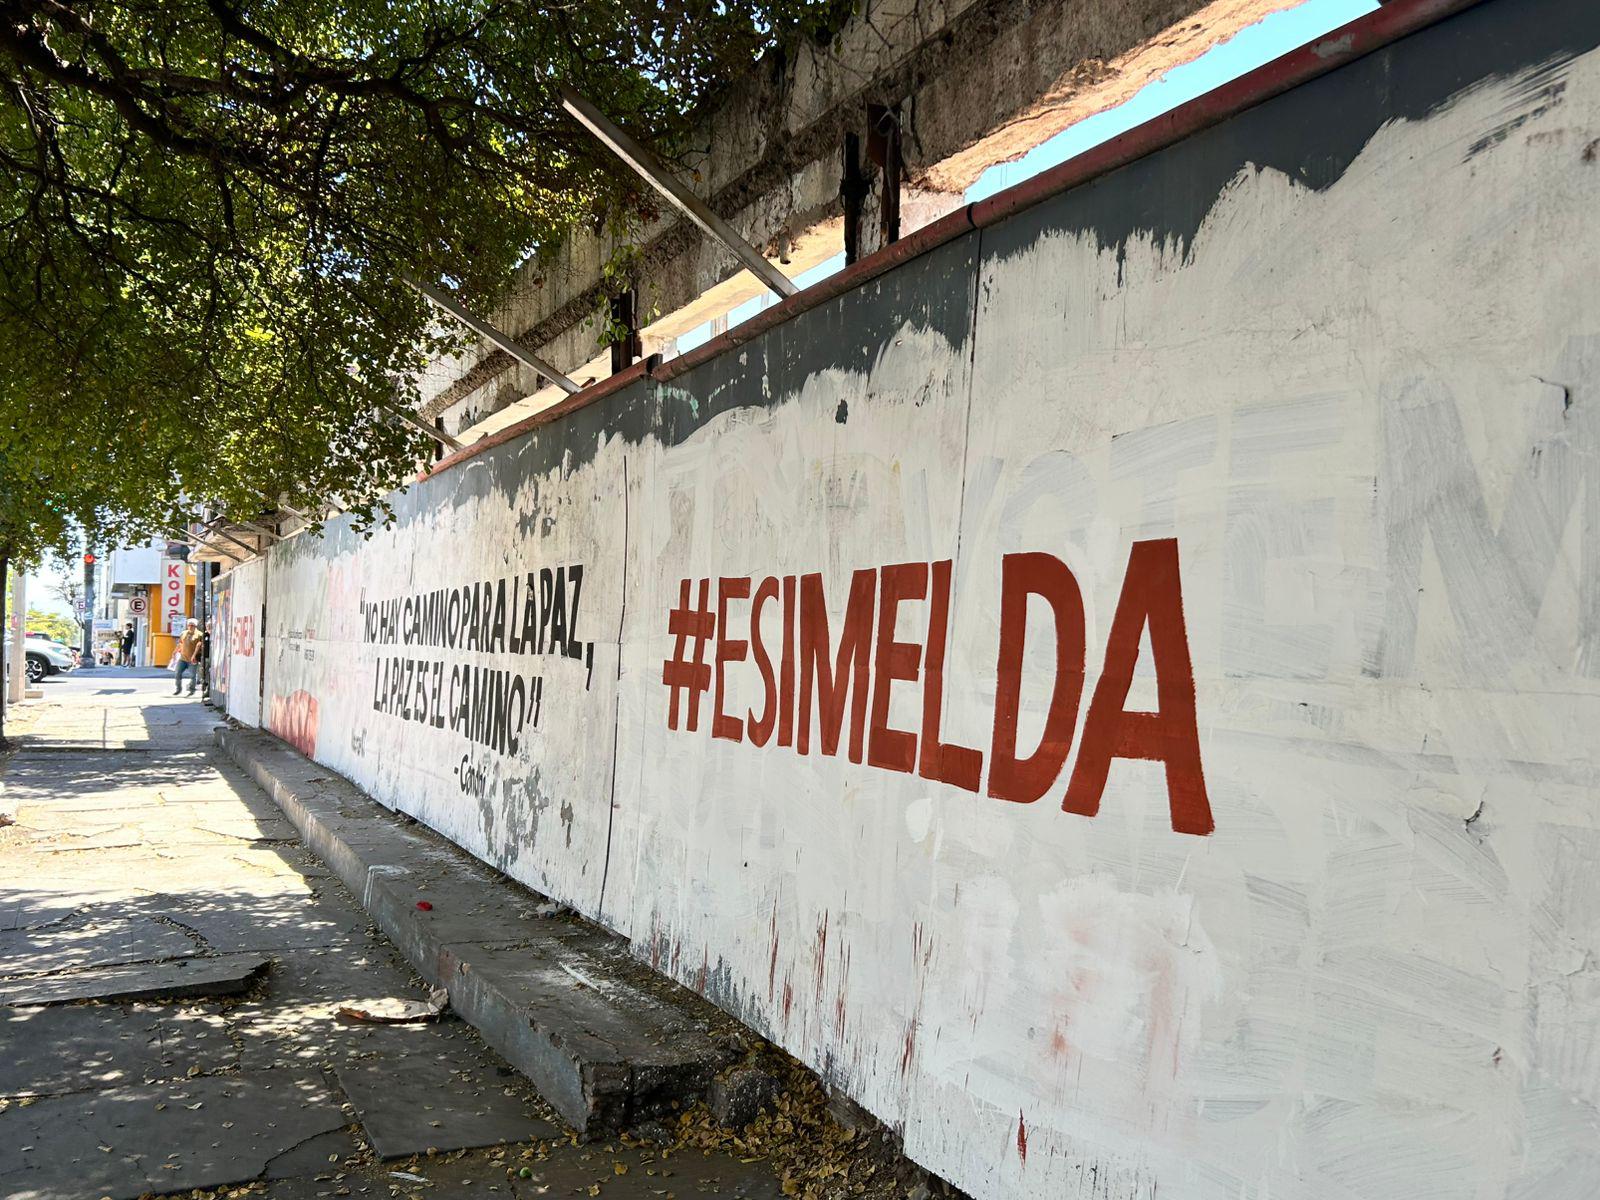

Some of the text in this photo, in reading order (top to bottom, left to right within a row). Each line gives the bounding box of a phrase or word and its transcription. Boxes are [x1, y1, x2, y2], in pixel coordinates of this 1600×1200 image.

[134, 601, 142, 609] E
[168, 564, 180, 633] Koda
[379, 596, 402, 644] HAY
[403, 588, 461, 649] CAMINO
[459, 578, 505, 653] PARA
[509, 572, 536, 655] LA
[373, 657, 389, 713] LA
[390, 657, 414, 720] PAZ
[413, 660, 429, 723] ES
[430, 661, 445, 728] EL
[663, 537, 1215, 836] #ESIMELDA
